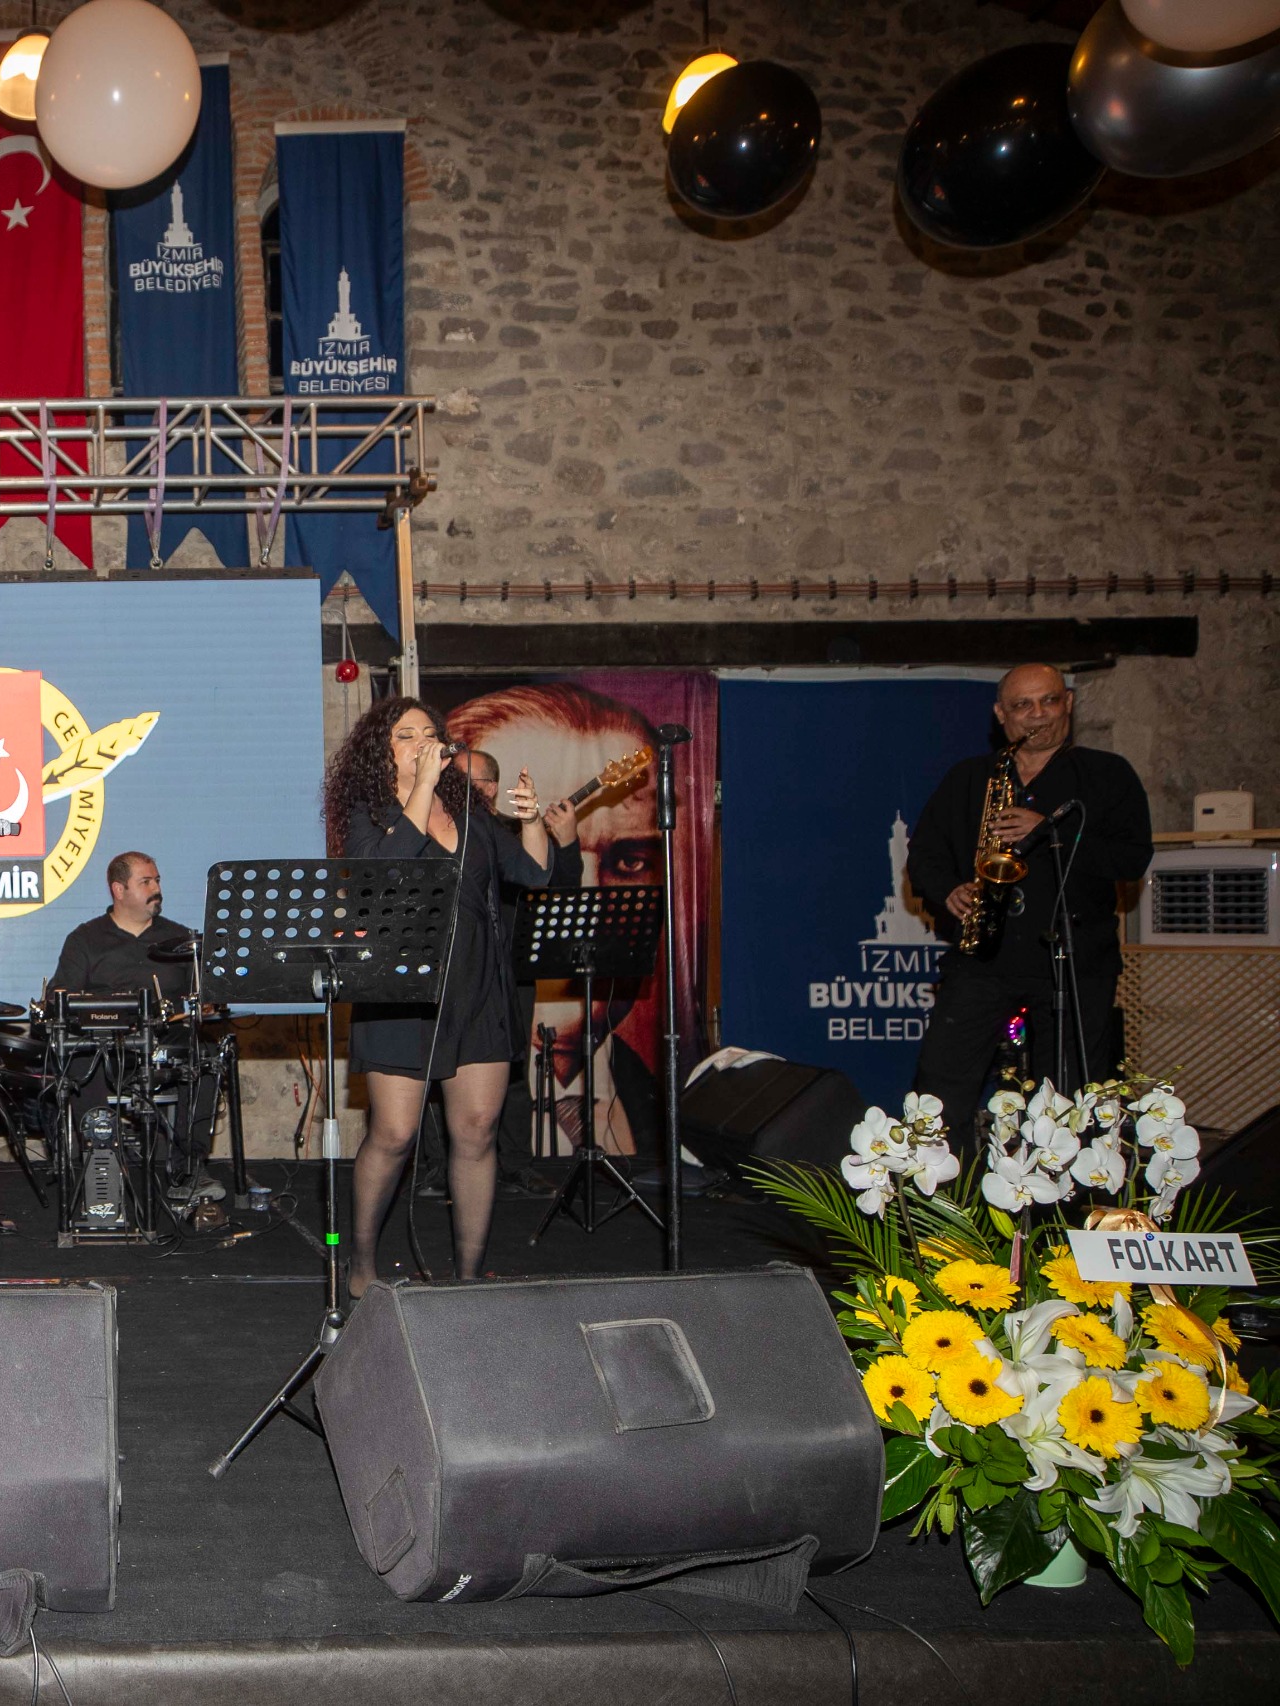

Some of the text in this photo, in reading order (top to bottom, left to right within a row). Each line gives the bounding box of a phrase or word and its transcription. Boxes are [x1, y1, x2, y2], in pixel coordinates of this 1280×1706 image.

[156, 244, 203, 260] İZMİR
[129, 255, 224, 279] BÜYÜKŞEHİR
[319, 339, 370, 356] İZMİR
[290, 354, 397, 378] BÜYÜKŞEHİR
[299, 375, 390, 394] BELEDİYESİ
[809, 976, 935, 1013] BÜYÜKŞ
[828, 1014, 930, 1041] BELEDİ
[1107, 1238, 1238, 1273] FOLKART
